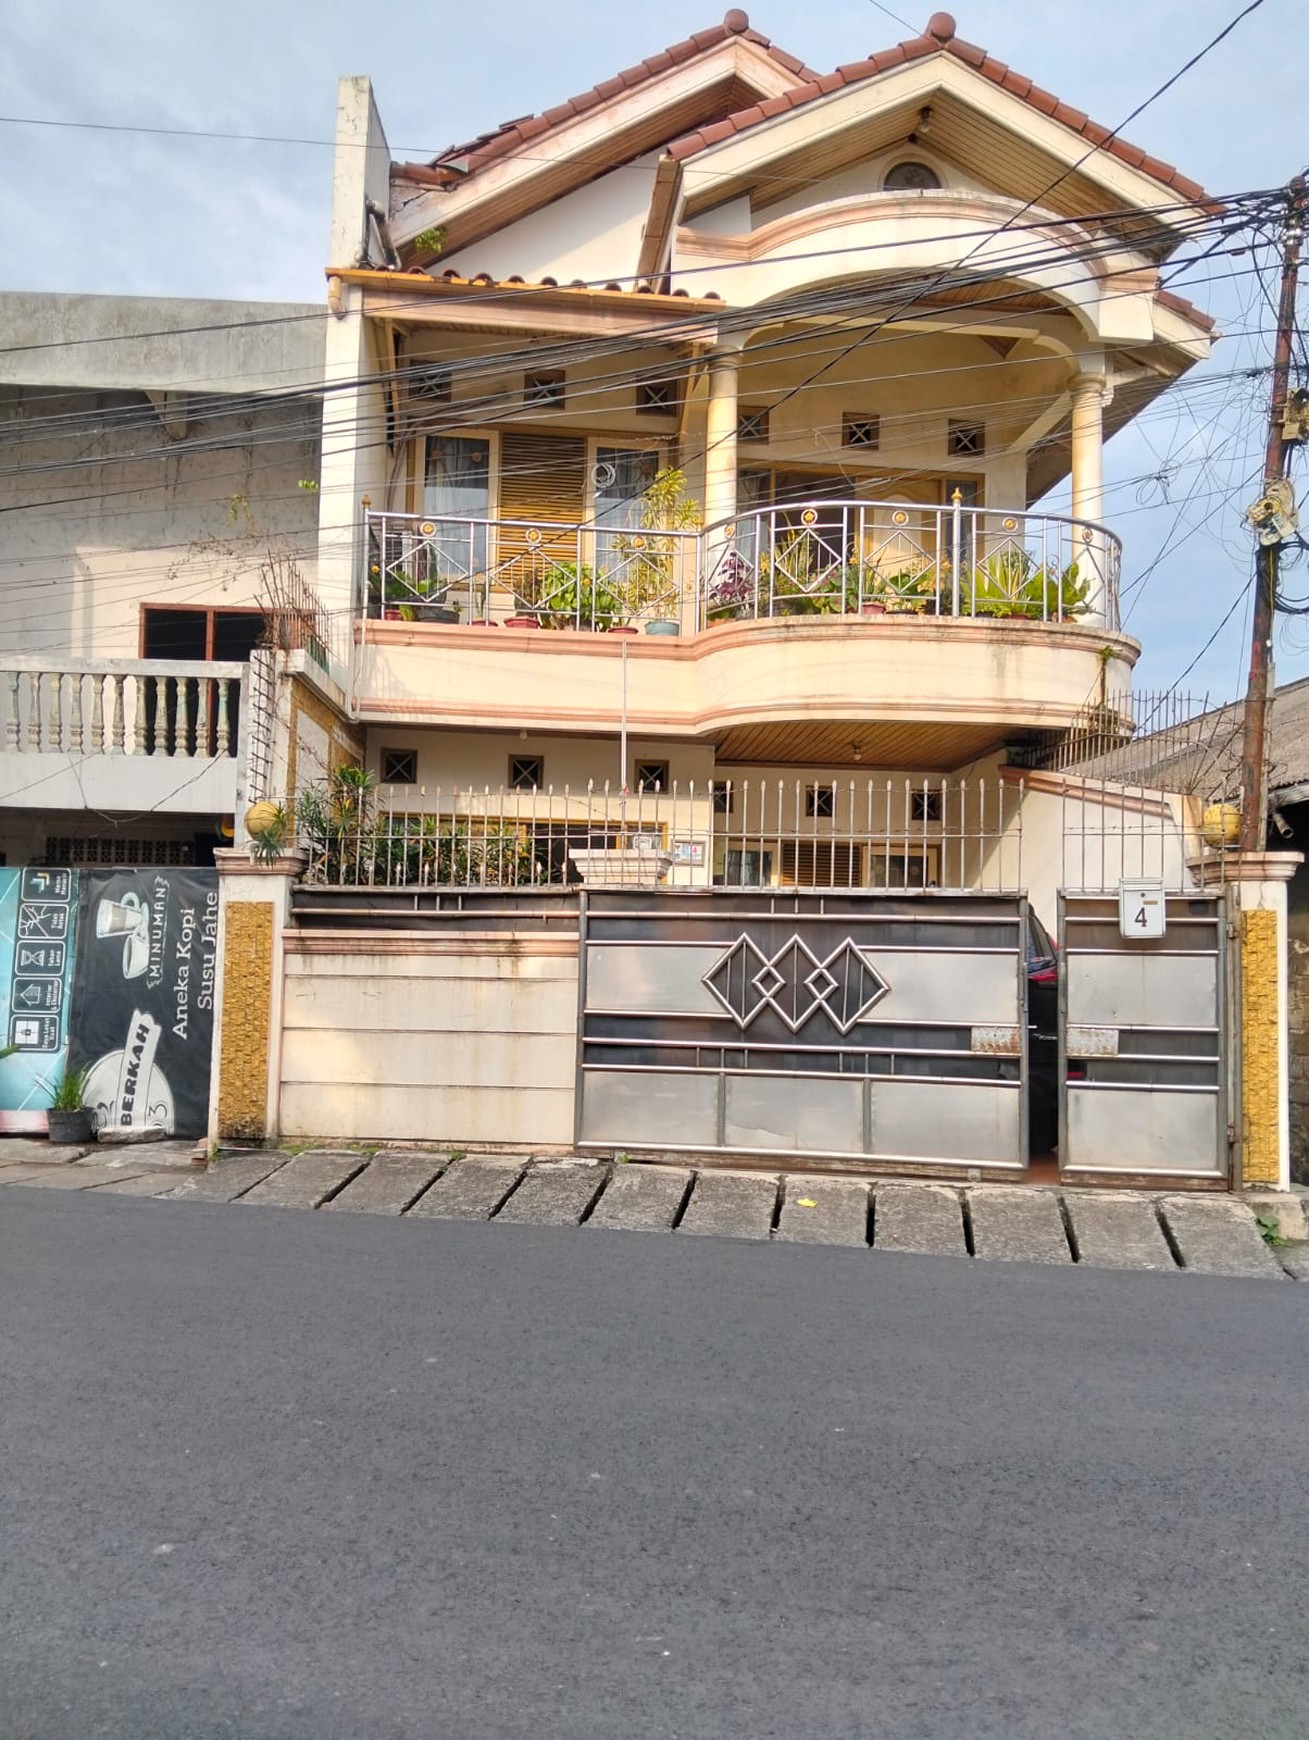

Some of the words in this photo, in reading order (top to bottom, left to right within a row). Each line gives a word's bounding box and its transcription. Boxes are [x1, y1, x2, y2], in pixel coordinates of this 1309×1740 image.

[149, 886, 166, 978] MINUMAN
[176, 908, 196, 960] Kopi
[200, 892, 218, 947] Jahe
[1134, 906, 1148, 928] 4
[172, 965, 189, 1040] Aneka
[198, 953, 215, 1010] Susu
[120, 1023, 150, 1126] BERKAH
